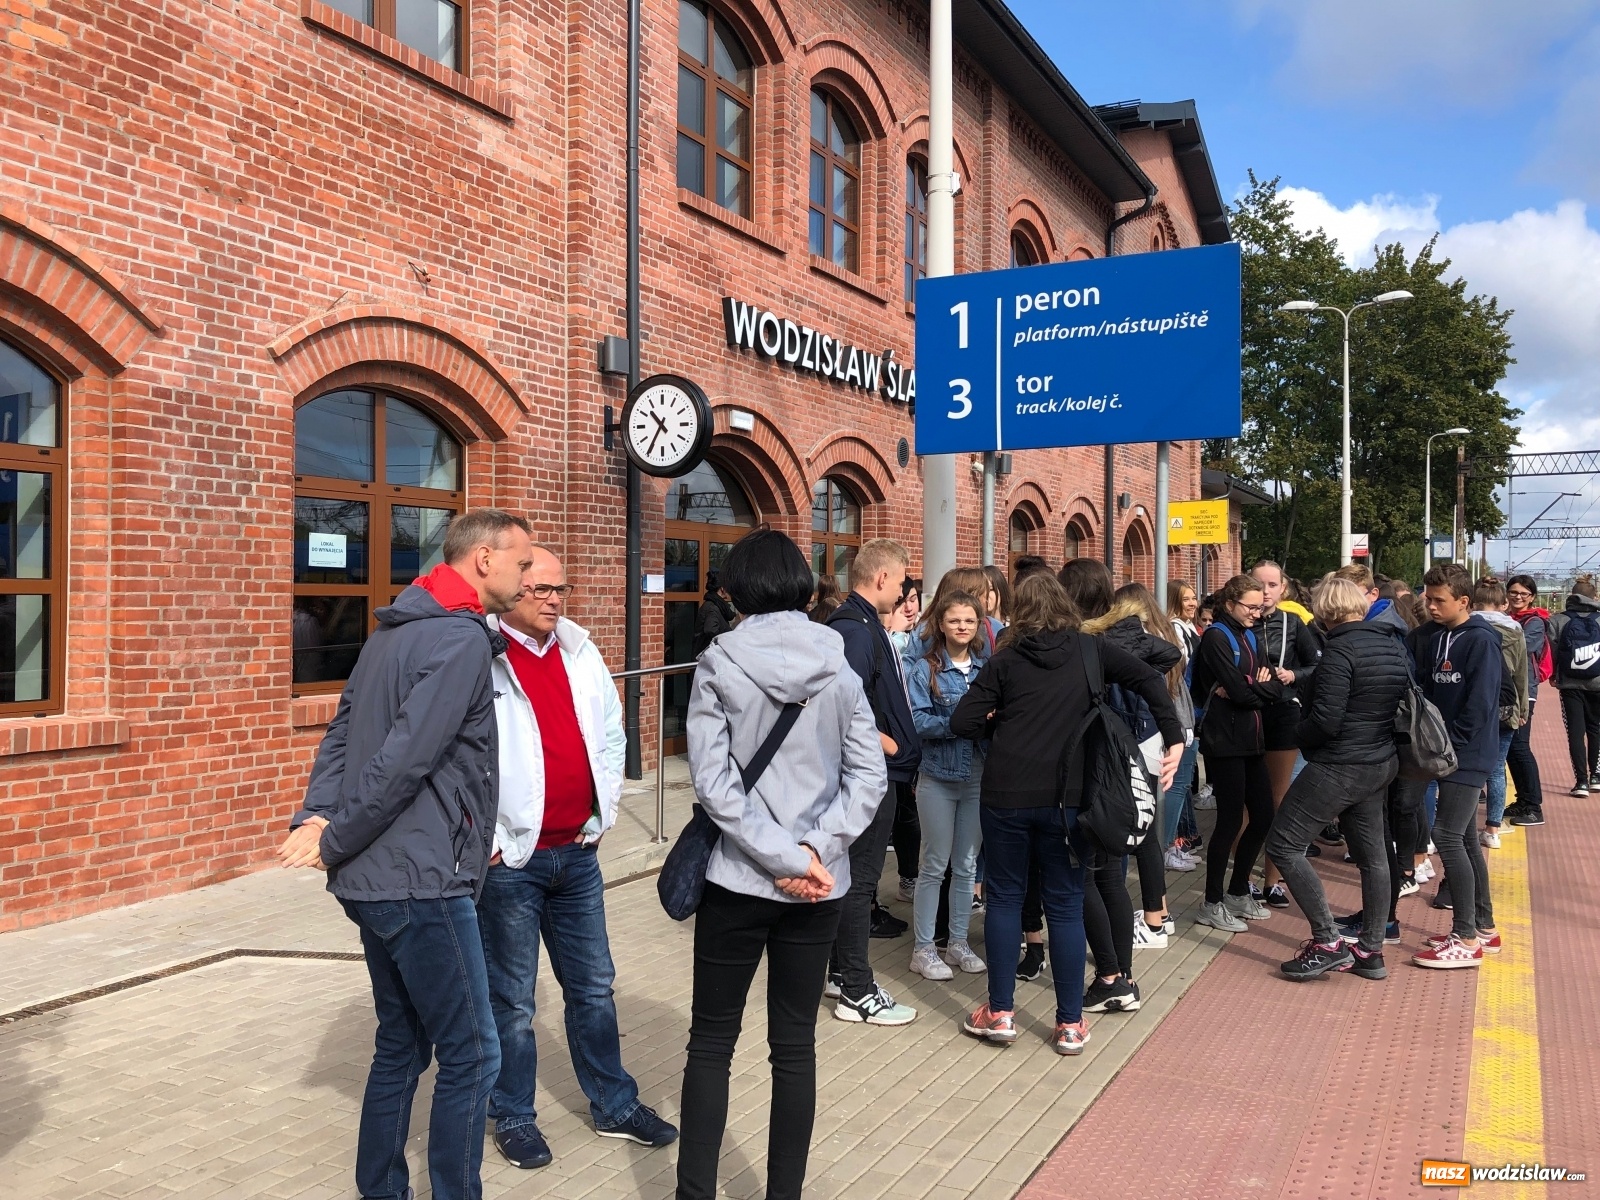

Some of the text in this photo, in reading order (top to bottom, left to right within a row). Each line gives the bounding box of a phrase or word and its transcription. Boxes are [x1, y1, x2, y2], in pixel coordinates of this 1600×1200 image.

[1015, 286, 1100, 320] peron
[949, 301, 969, 349] 1
[1013, 310, 1209, 347] platform/nástupiště
[729, 297, 881, 392] WODZISŁAW
[946, 378, 973, 420] 3
[1015, 374, 1054, 394] tor
[1016, 394, 1123, 415] track/kolej č.
